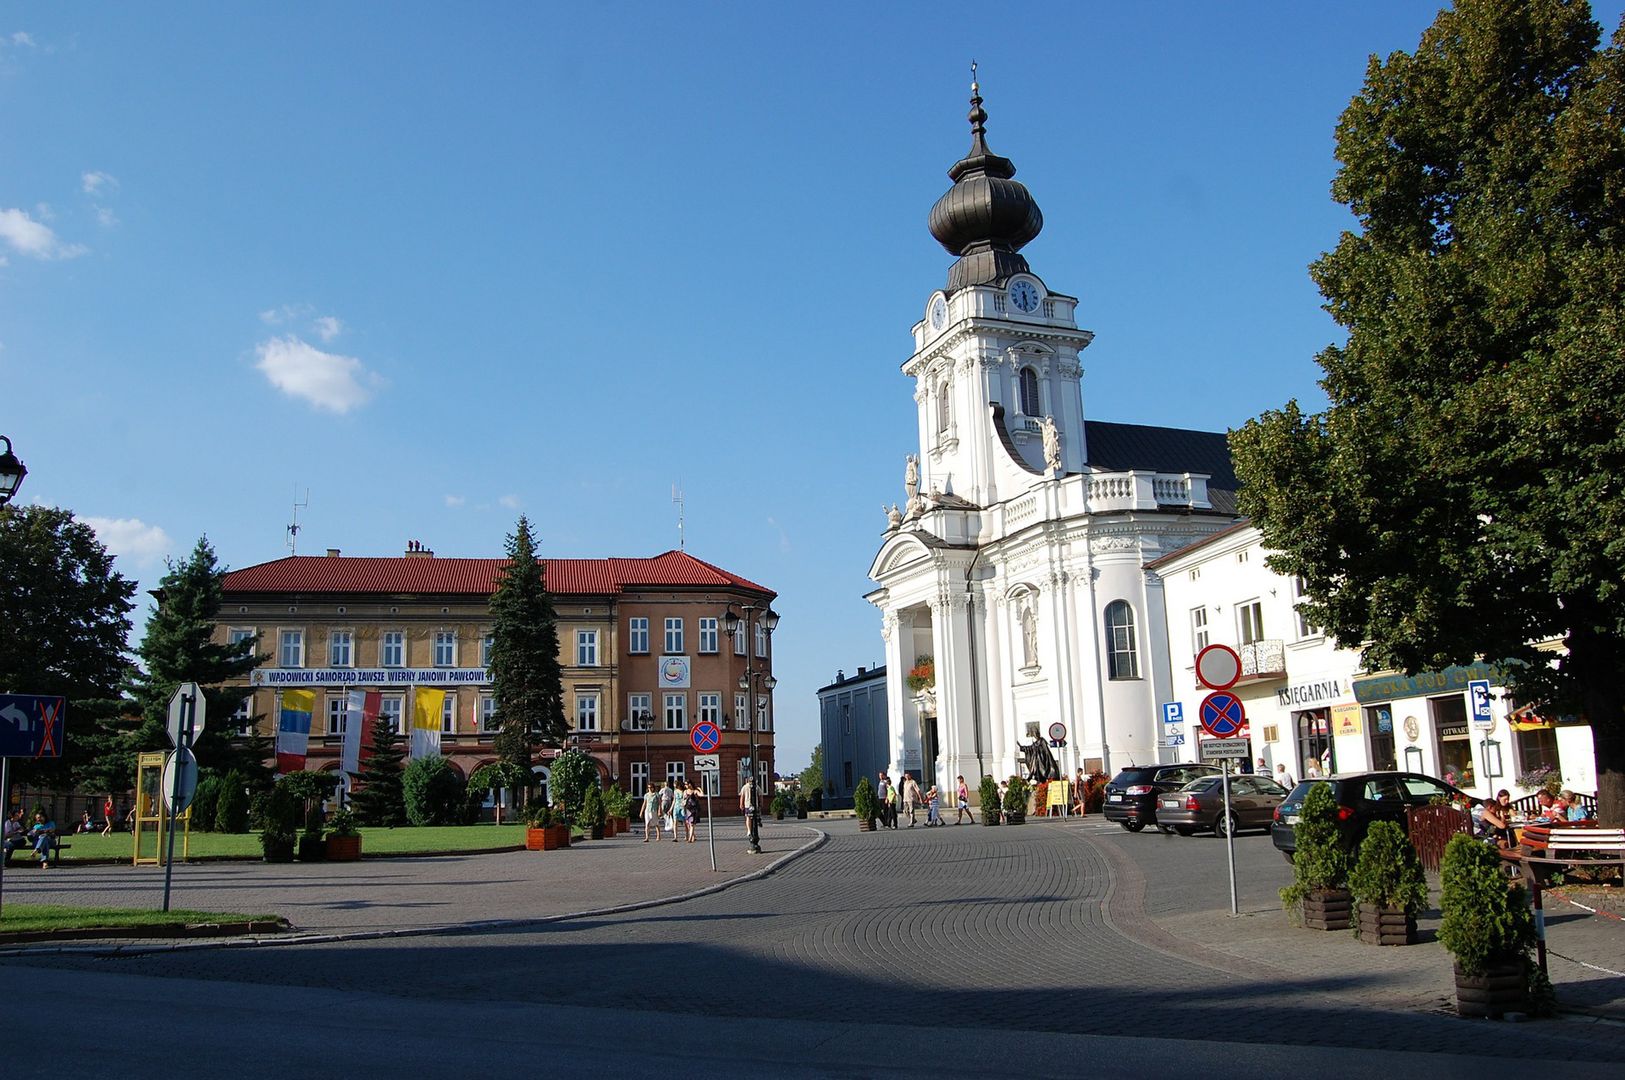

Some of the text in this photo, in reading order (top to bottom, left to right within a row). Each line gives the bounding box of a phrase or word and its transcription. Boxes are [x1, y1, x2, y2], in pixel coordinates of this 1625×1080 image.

[269, 672, 313, 682] WADOWICKI
[315, 672, 356, 684] SAMORZĄD
[358, 672, 385, 682] ZAWSZE
[388, 671, 416, 682] WIERNY
[418, 671, 446, 682] JANOWI
[449, 671, 484, 682] PAWŁOWI
[1278, 680, 1341, 706] KSIĘGARNIA
[1472, 686, 1486, 715] P
[1168, 704, 1179, 721] P
